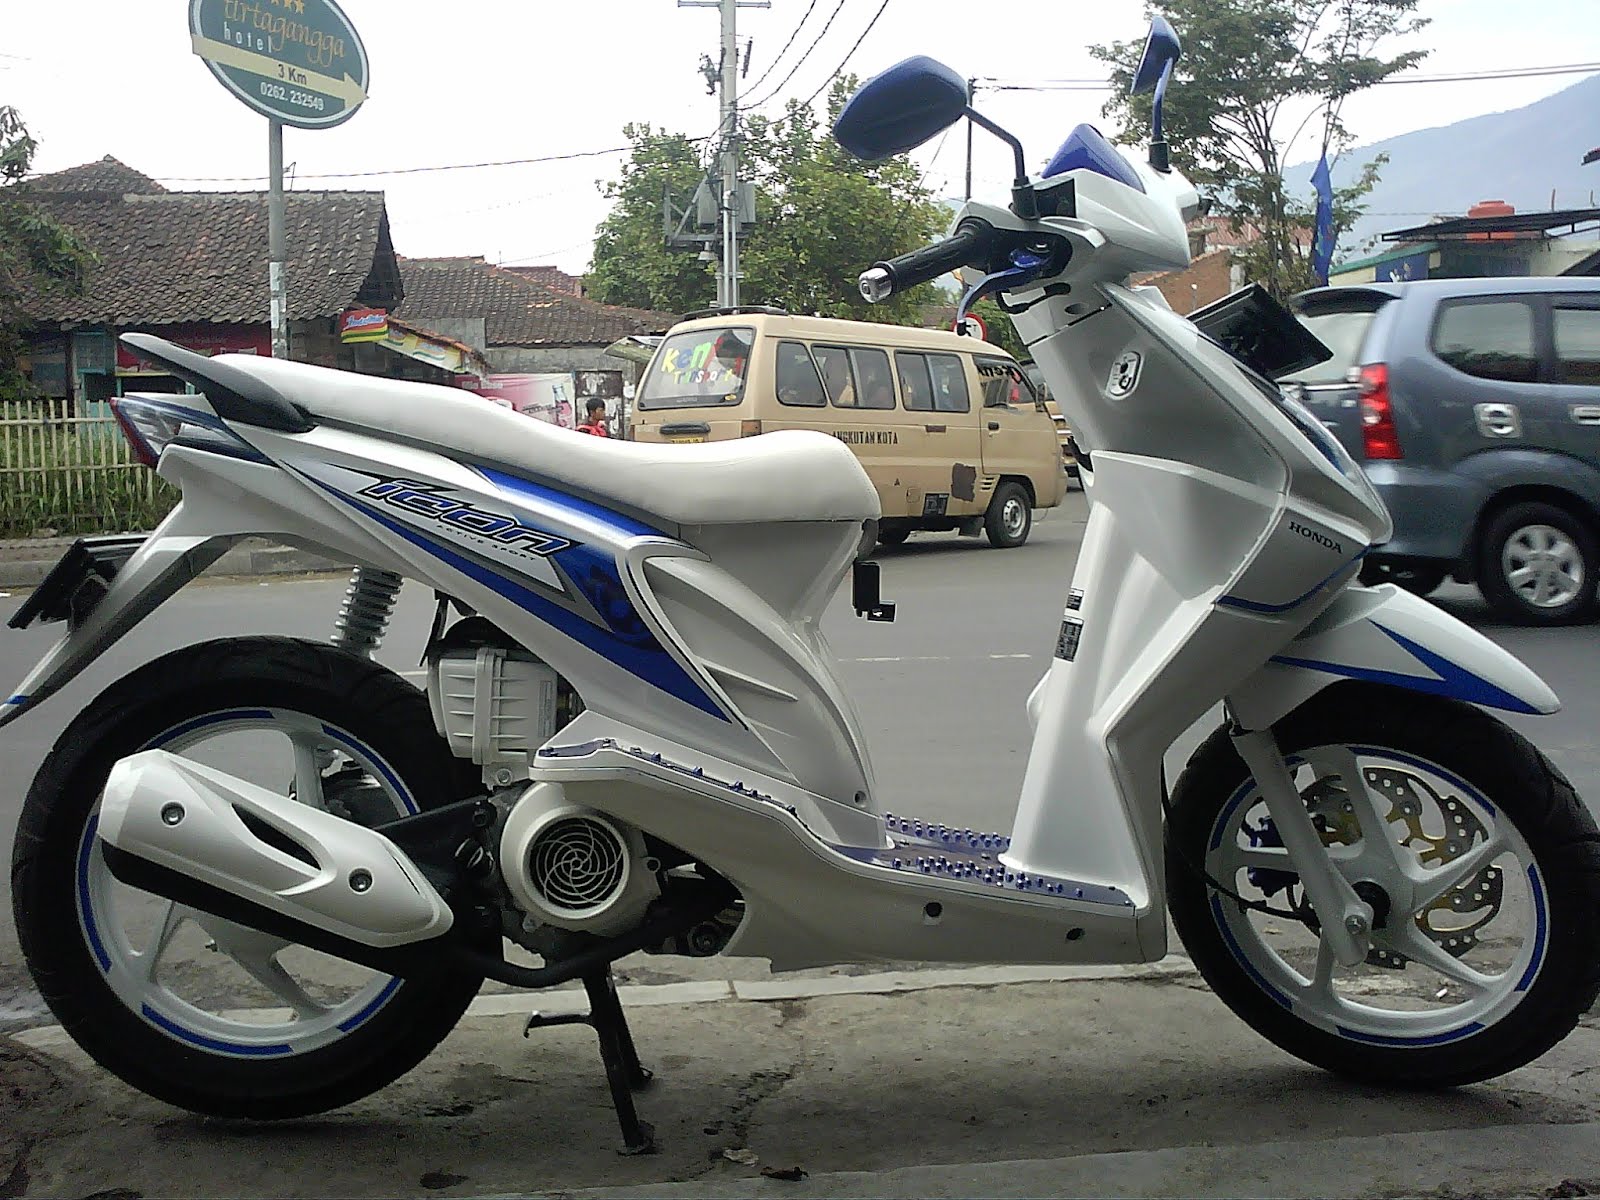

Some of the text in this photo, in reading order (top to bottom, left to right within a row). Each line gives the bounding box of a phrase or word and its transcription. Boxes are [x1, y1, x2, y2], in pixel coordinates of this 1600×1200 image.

[224, 21, 272, 53] hotel
[278, 63, 307, 86] 3 Km
[877, 431, 898, 444] KOTA
[436, 524, 536, 561] ACTIVE SPORT
[1289, 521, 1342, 554] HONDA
